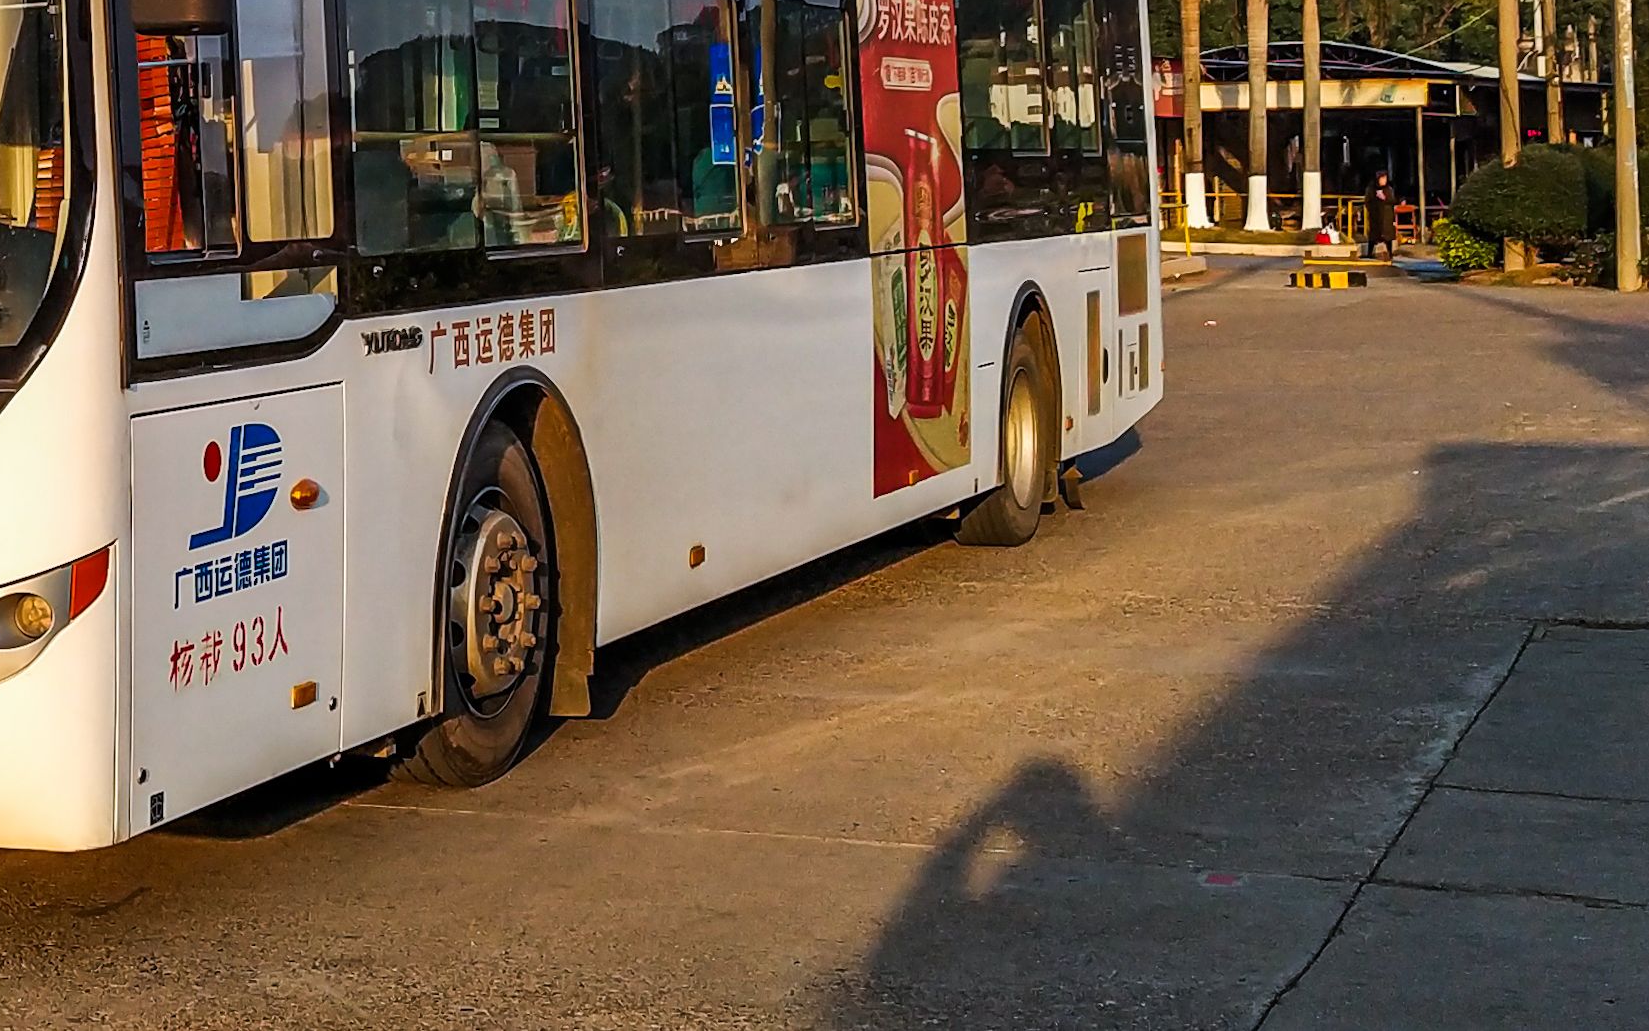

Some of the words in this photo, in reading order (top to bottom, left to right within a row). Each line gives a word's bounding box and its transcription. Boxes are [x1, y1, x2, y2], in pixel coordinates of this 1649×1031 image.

[360, 326, 423, 357] YUTONG
[428, 308, 556, 375] 广西运德集团
[174, 539, 288, 610] 广西运德集团
